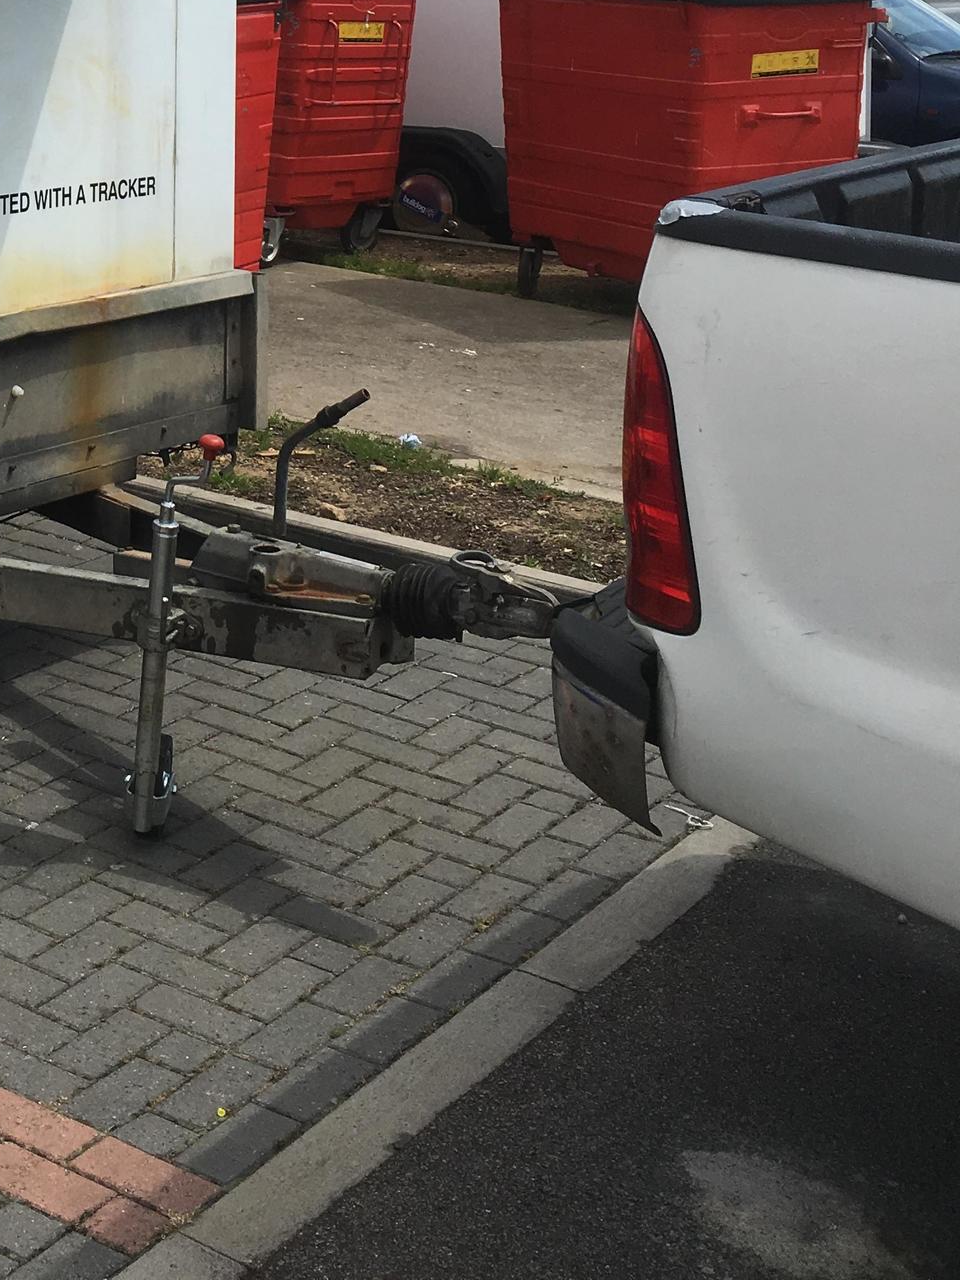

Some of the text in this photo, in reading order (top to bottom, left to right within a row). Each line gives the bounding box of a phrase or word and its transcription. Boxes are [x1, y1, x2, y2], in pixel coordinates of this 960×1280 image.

[34, 186, 72, 211] WITH
[75, 184, 86, 205] A
[89, 176, 156, 203] TRACKER
[402, 193, 426, 214] bulldog
